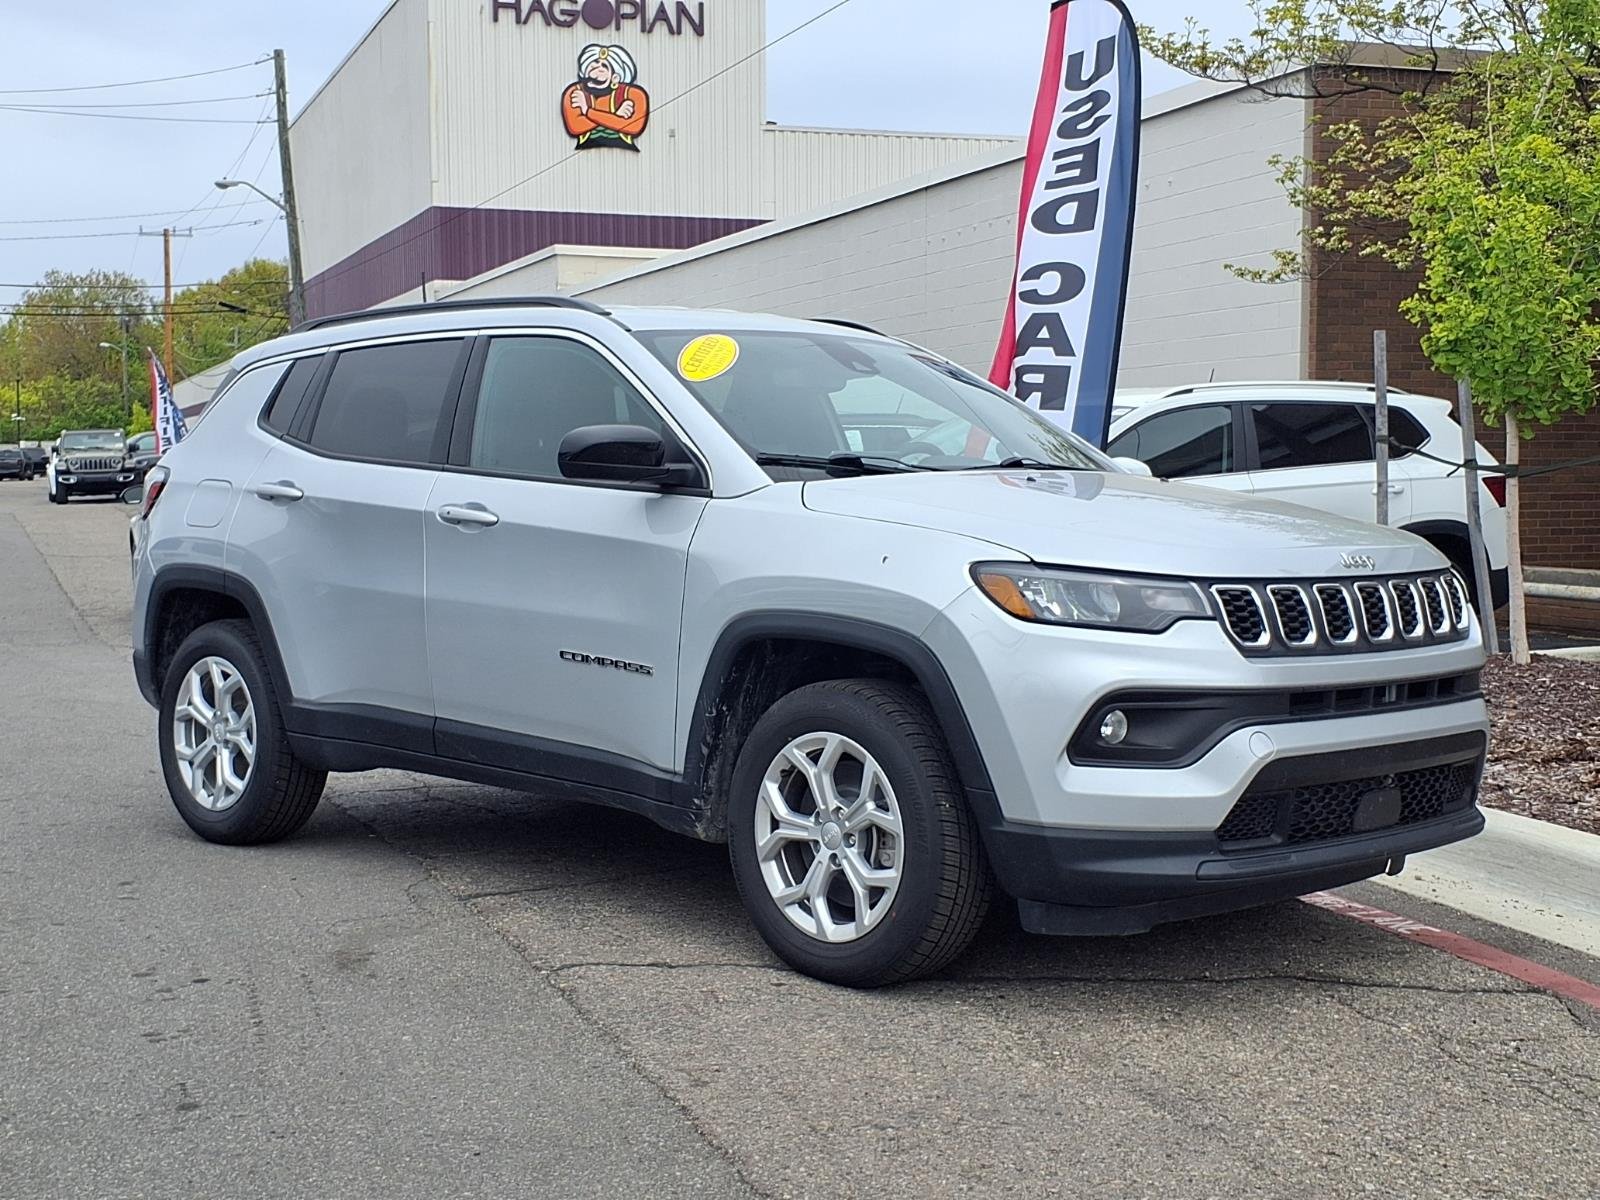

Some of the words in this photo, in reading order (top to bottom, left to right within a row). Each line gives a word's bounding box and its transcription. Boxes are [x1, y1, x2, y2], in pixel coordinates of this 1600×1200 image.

[492, 0, 705, 36] HAGOPIAN
[683, 336, 720, 373] CERTIFIED
[1339, 552, 1376, 571] Jeep
[559, 649, 654, 677] COMPASS
